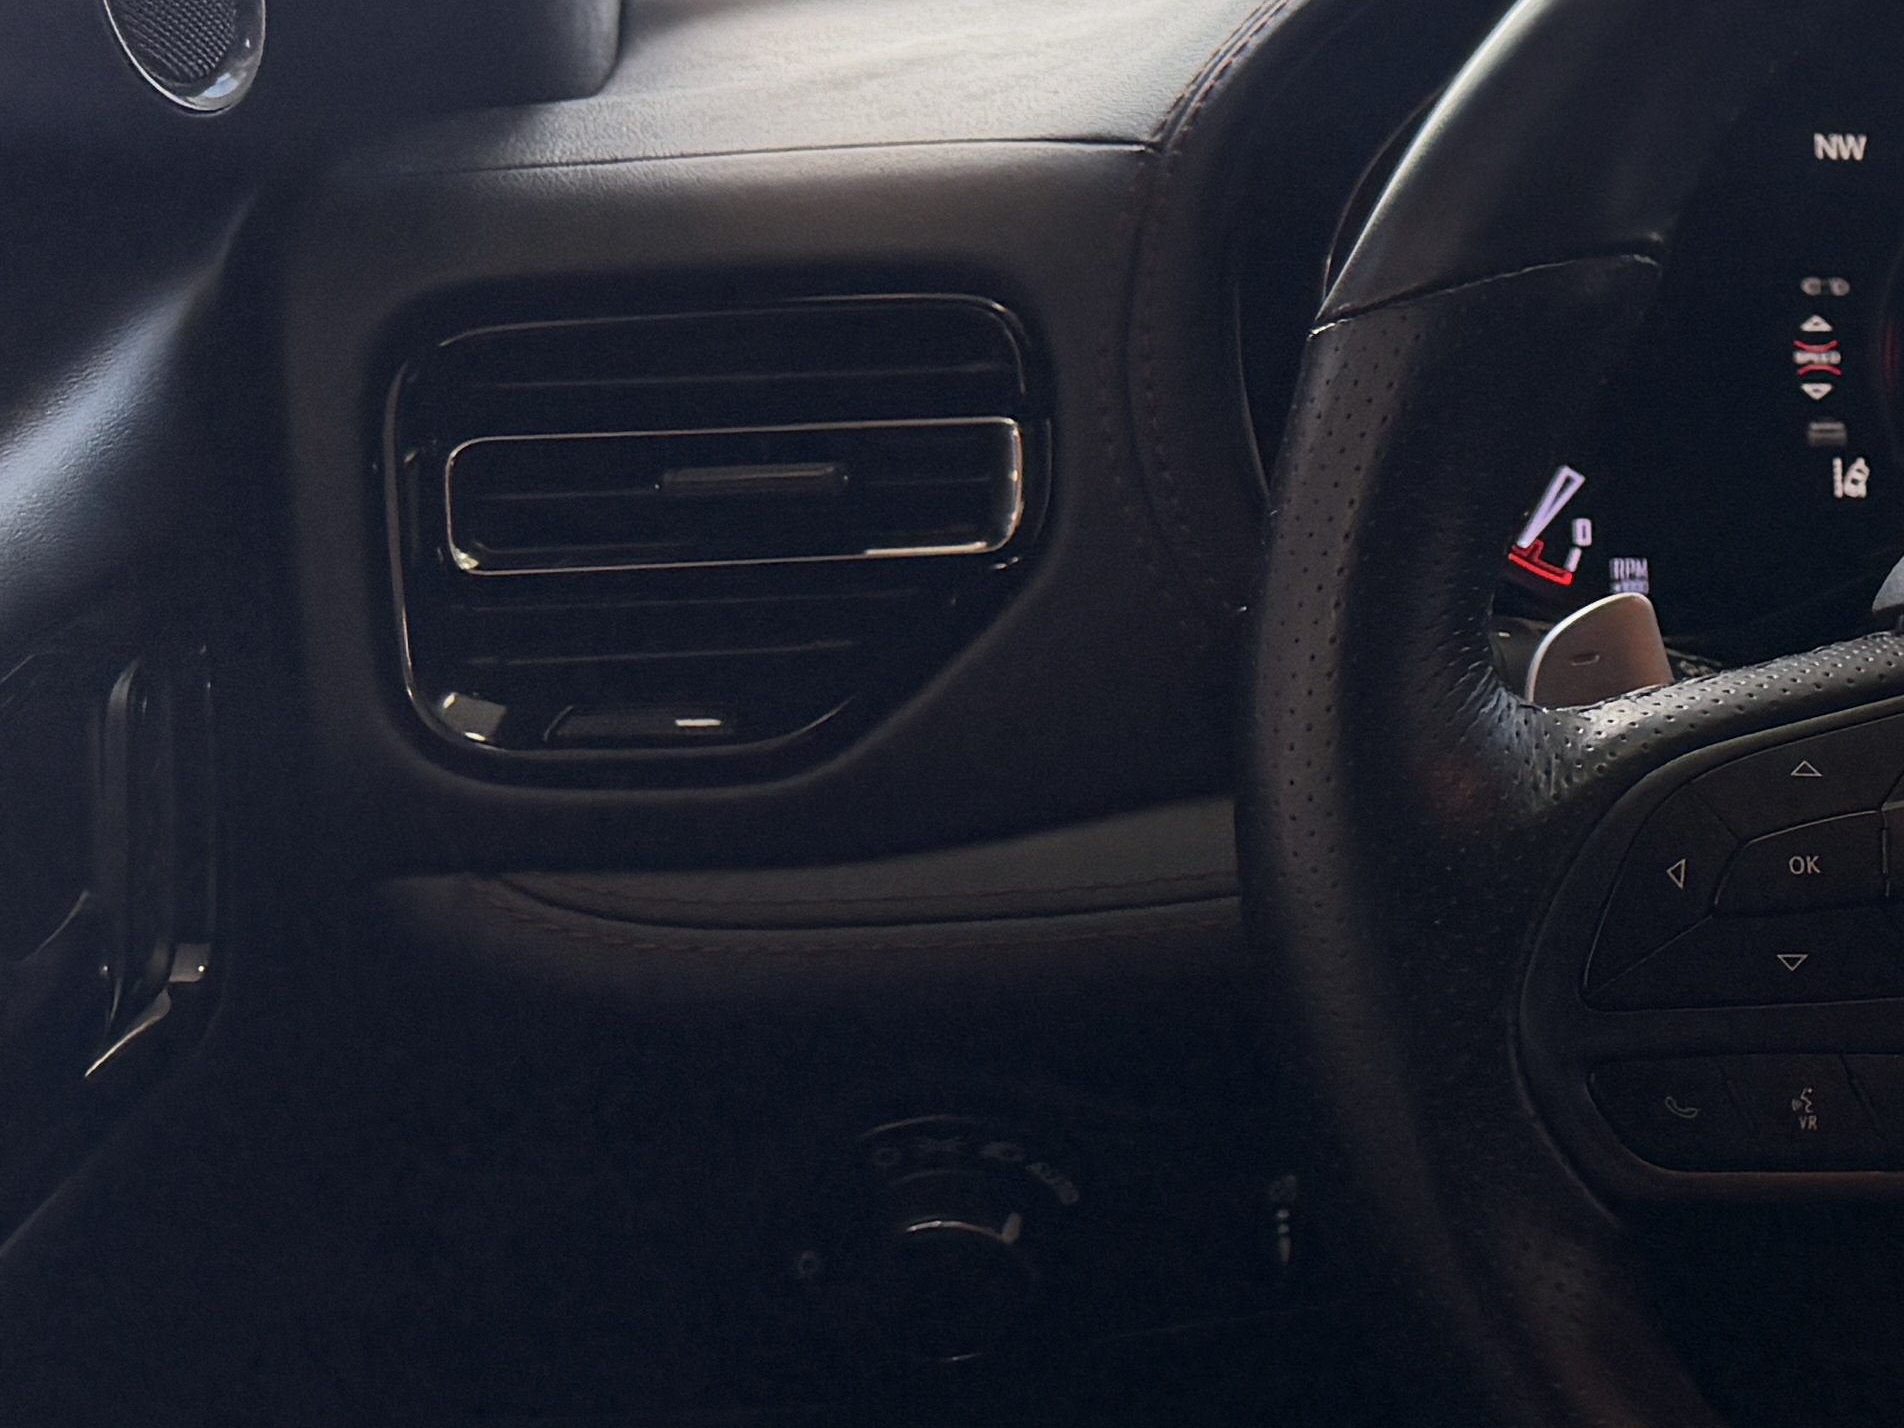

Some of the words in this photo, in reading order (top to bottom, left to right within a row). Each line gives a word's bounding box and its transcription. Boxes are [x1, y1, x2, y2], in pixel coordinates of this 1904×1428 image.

[1813, 133, 1867, 161] NW
[1609, 557, 1649, 580] RPM
[1788, 855, 1821, 875] OK
[1799, 1115, 1819, 1131] VR
